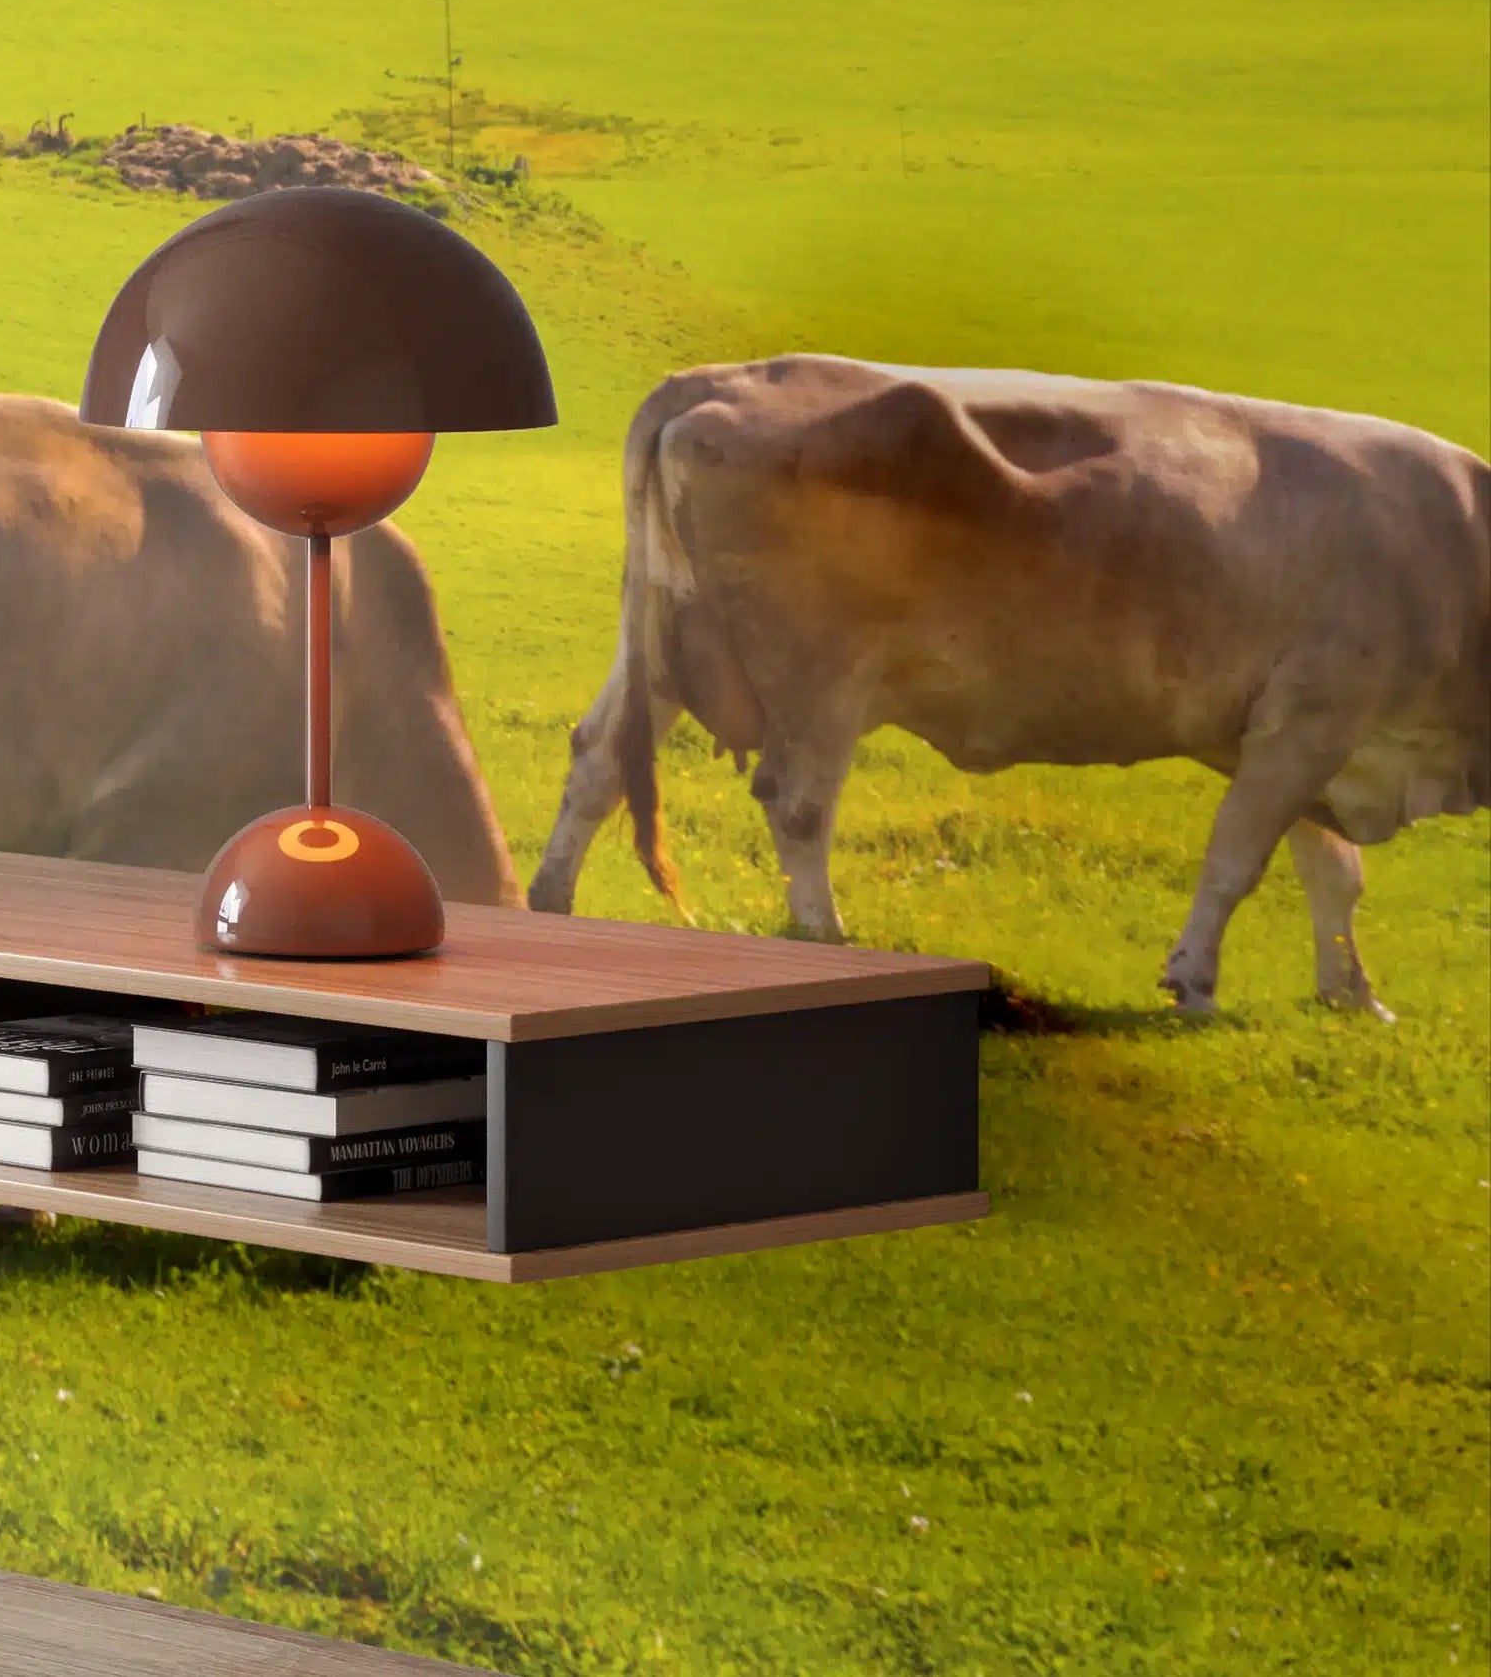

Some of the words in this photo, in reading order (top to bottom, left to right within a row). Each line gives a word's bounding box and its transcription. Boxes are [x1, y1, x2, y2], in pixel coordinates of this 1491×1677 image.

[68, 1070, 83, 1083] JANE
[331, 1062, 351, 1079] John
[353, 1060, 361, 1073] le
[362, 1057, 387, 1072] Carré
[81, 1102, 104, 1117] JOHN
[331, 1140, 395, 1161] MANHATTAN
[398, 1133, 455, 1154] VOYAGERS
[392, 1168, 412, 1191] THE
[416, 1161, 473, 1187] OUTSIDERS
